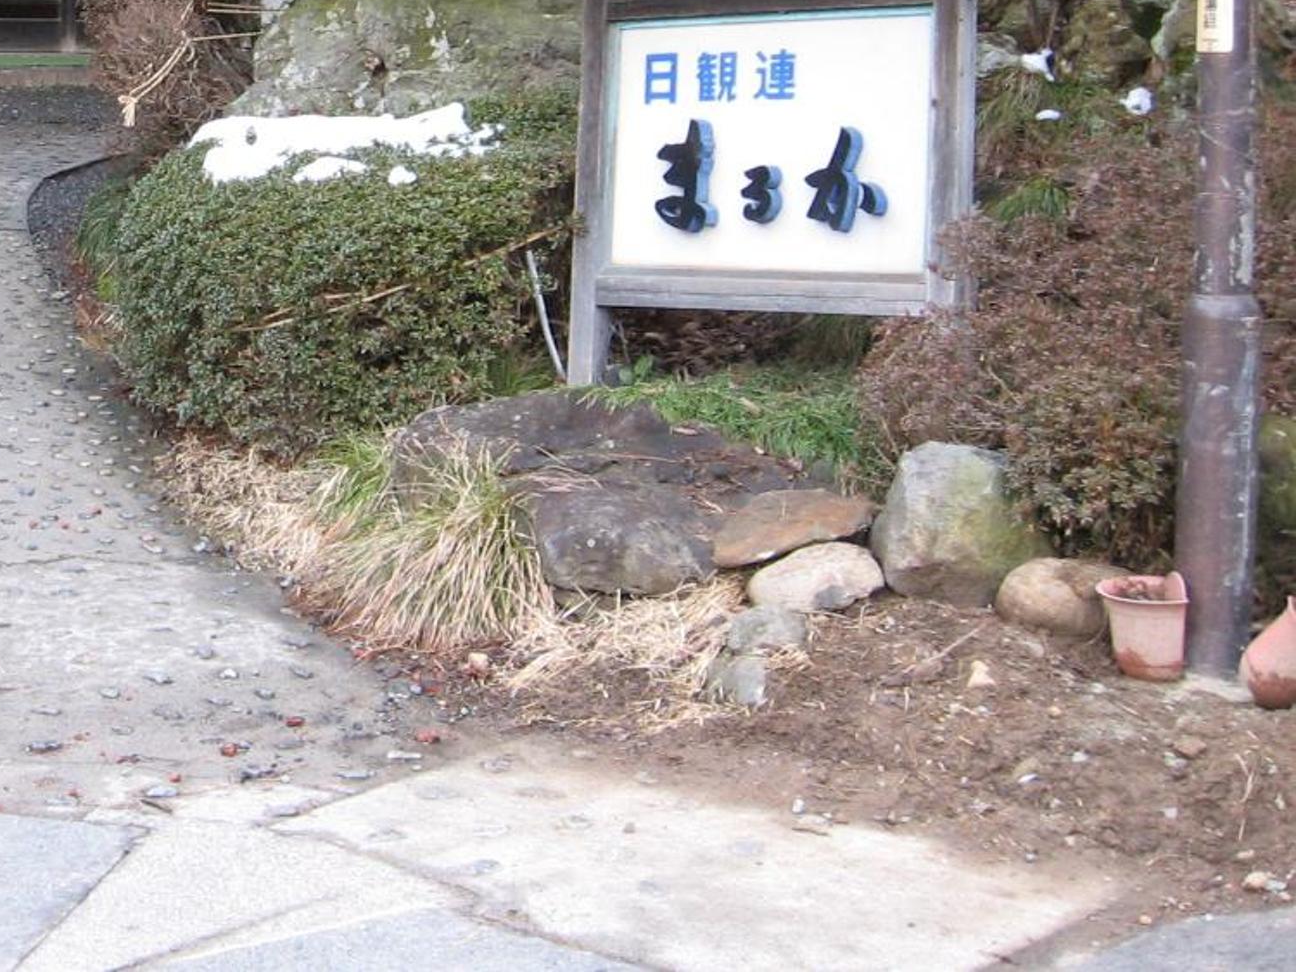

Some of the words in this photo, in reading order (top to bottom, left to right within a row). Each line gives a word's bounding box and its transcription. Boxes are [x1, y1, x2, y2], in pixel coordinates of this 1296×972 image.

[644, 49, 797, 105] 日観連
[654, 119, 889, 234] まるか
